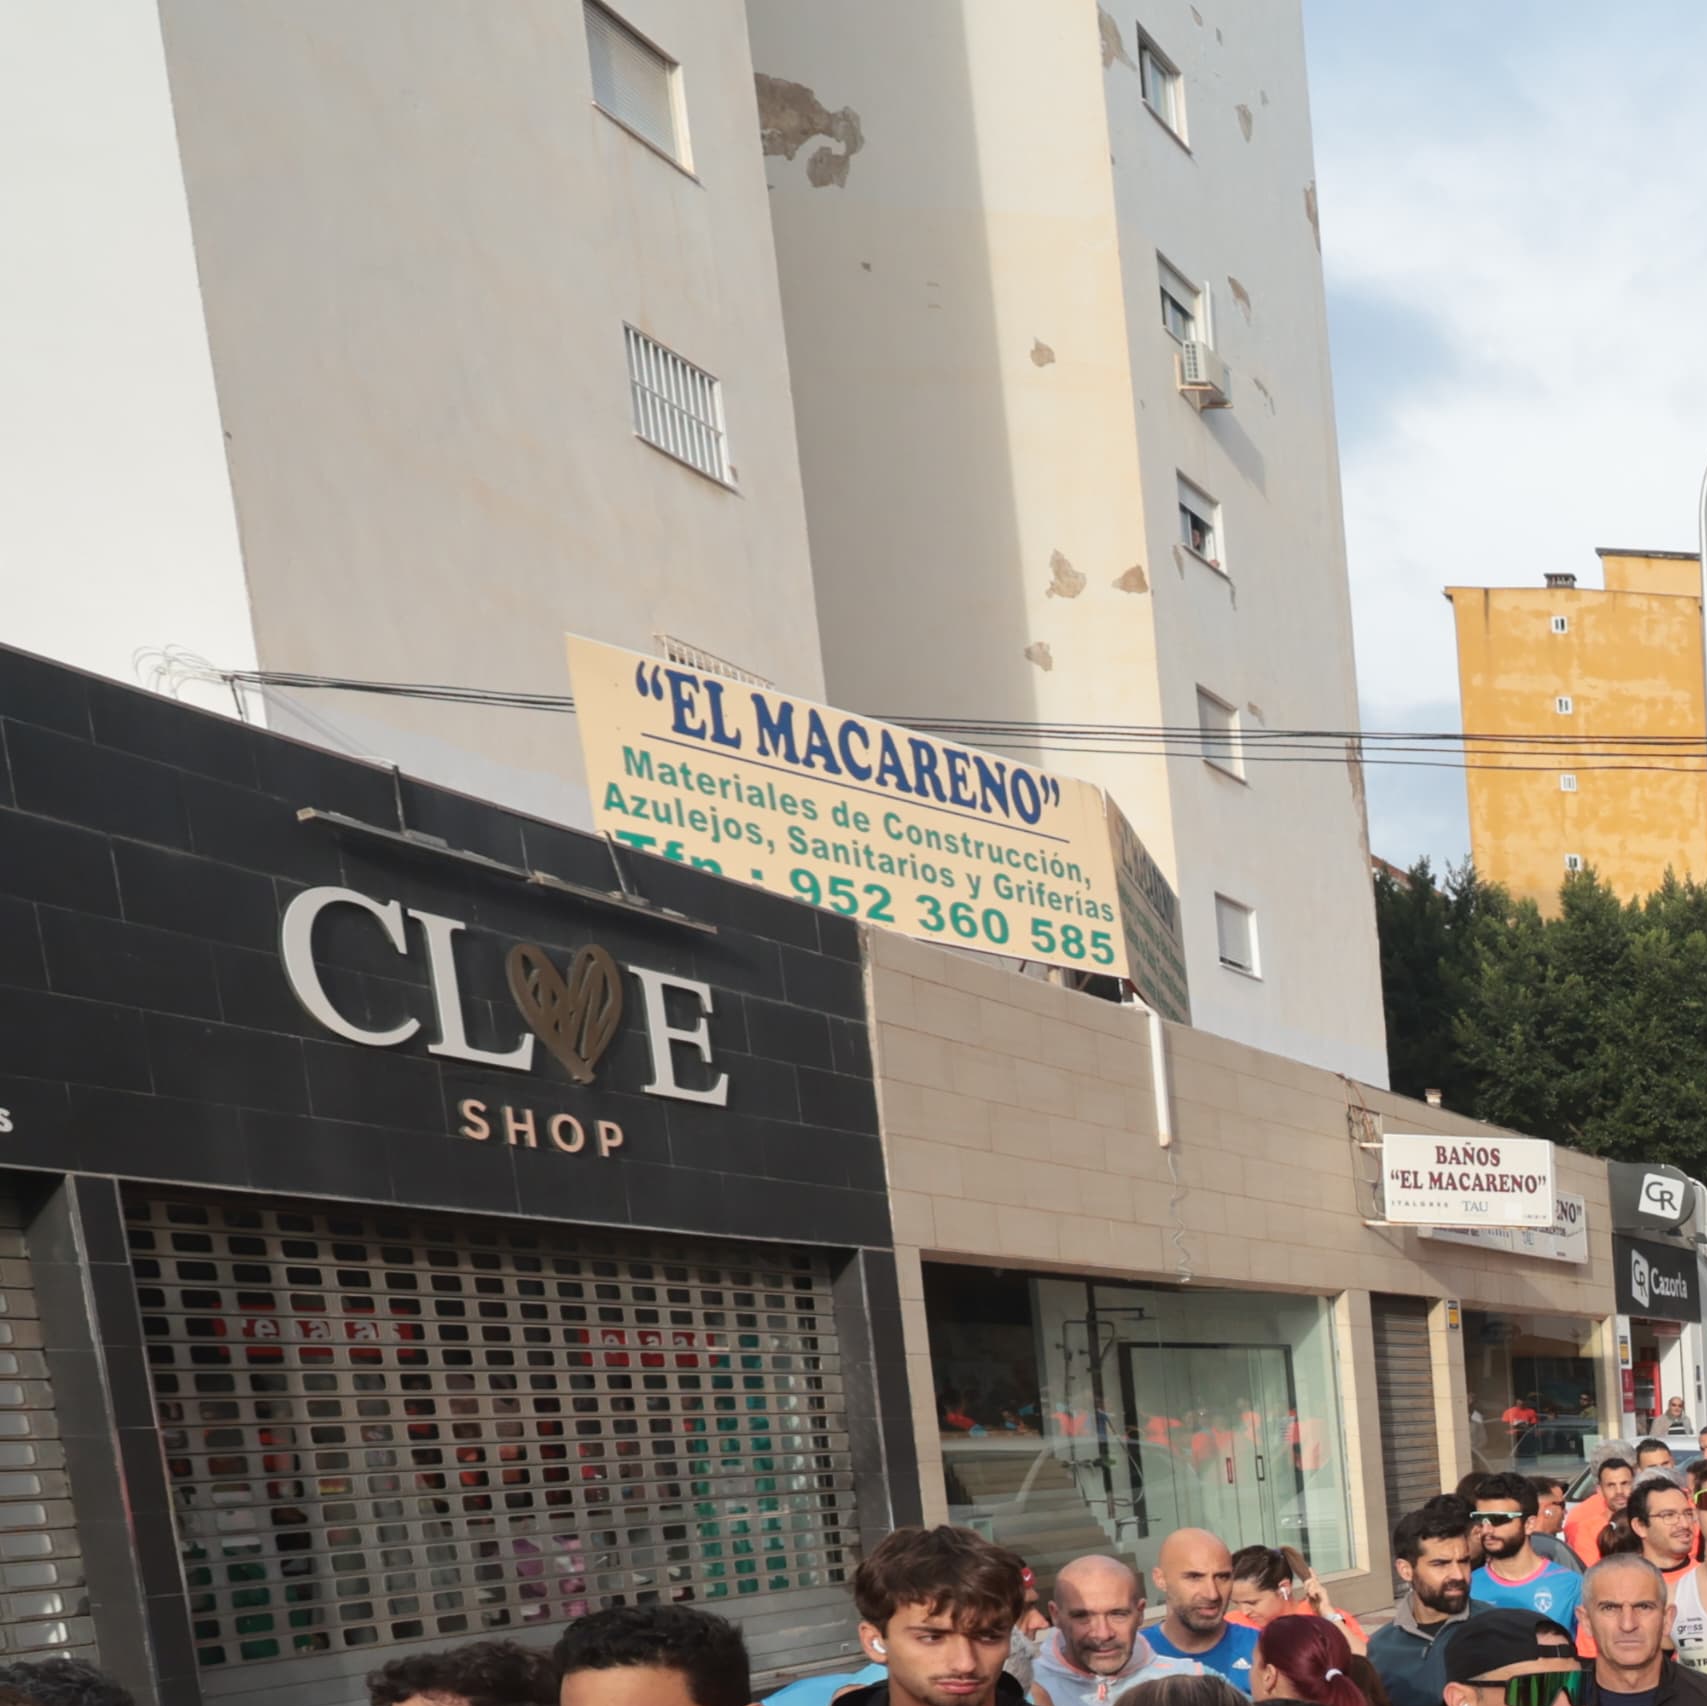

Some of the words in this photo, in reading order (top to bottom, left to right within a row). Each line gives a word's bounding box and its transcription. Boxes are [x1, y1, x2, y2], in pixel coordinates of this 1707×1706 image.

[622, 745, 818, 820] Materiales
[832, 801, 871, 833] de
[883, 813, 1092, 890] Construcción,
[603, 783, 776, 855] Azulejos,
[788, 826, 956, 888] Sanitarios
[967, 872, 981, 896] y
[993, 873, 1115, 922] Griferías
[789, 868, 896, 923] 952
[917, 894, 1009, 946] 360
[1030, 917, 1116, 966] 585
[458, 1099, 625, 1159] SHOP
[1435, 1142, 1501, 1167] BAÑOS
[1462, 1200, 1489, 1212] TAU
[1650, 1267, 1688, 1300] Cazorla
